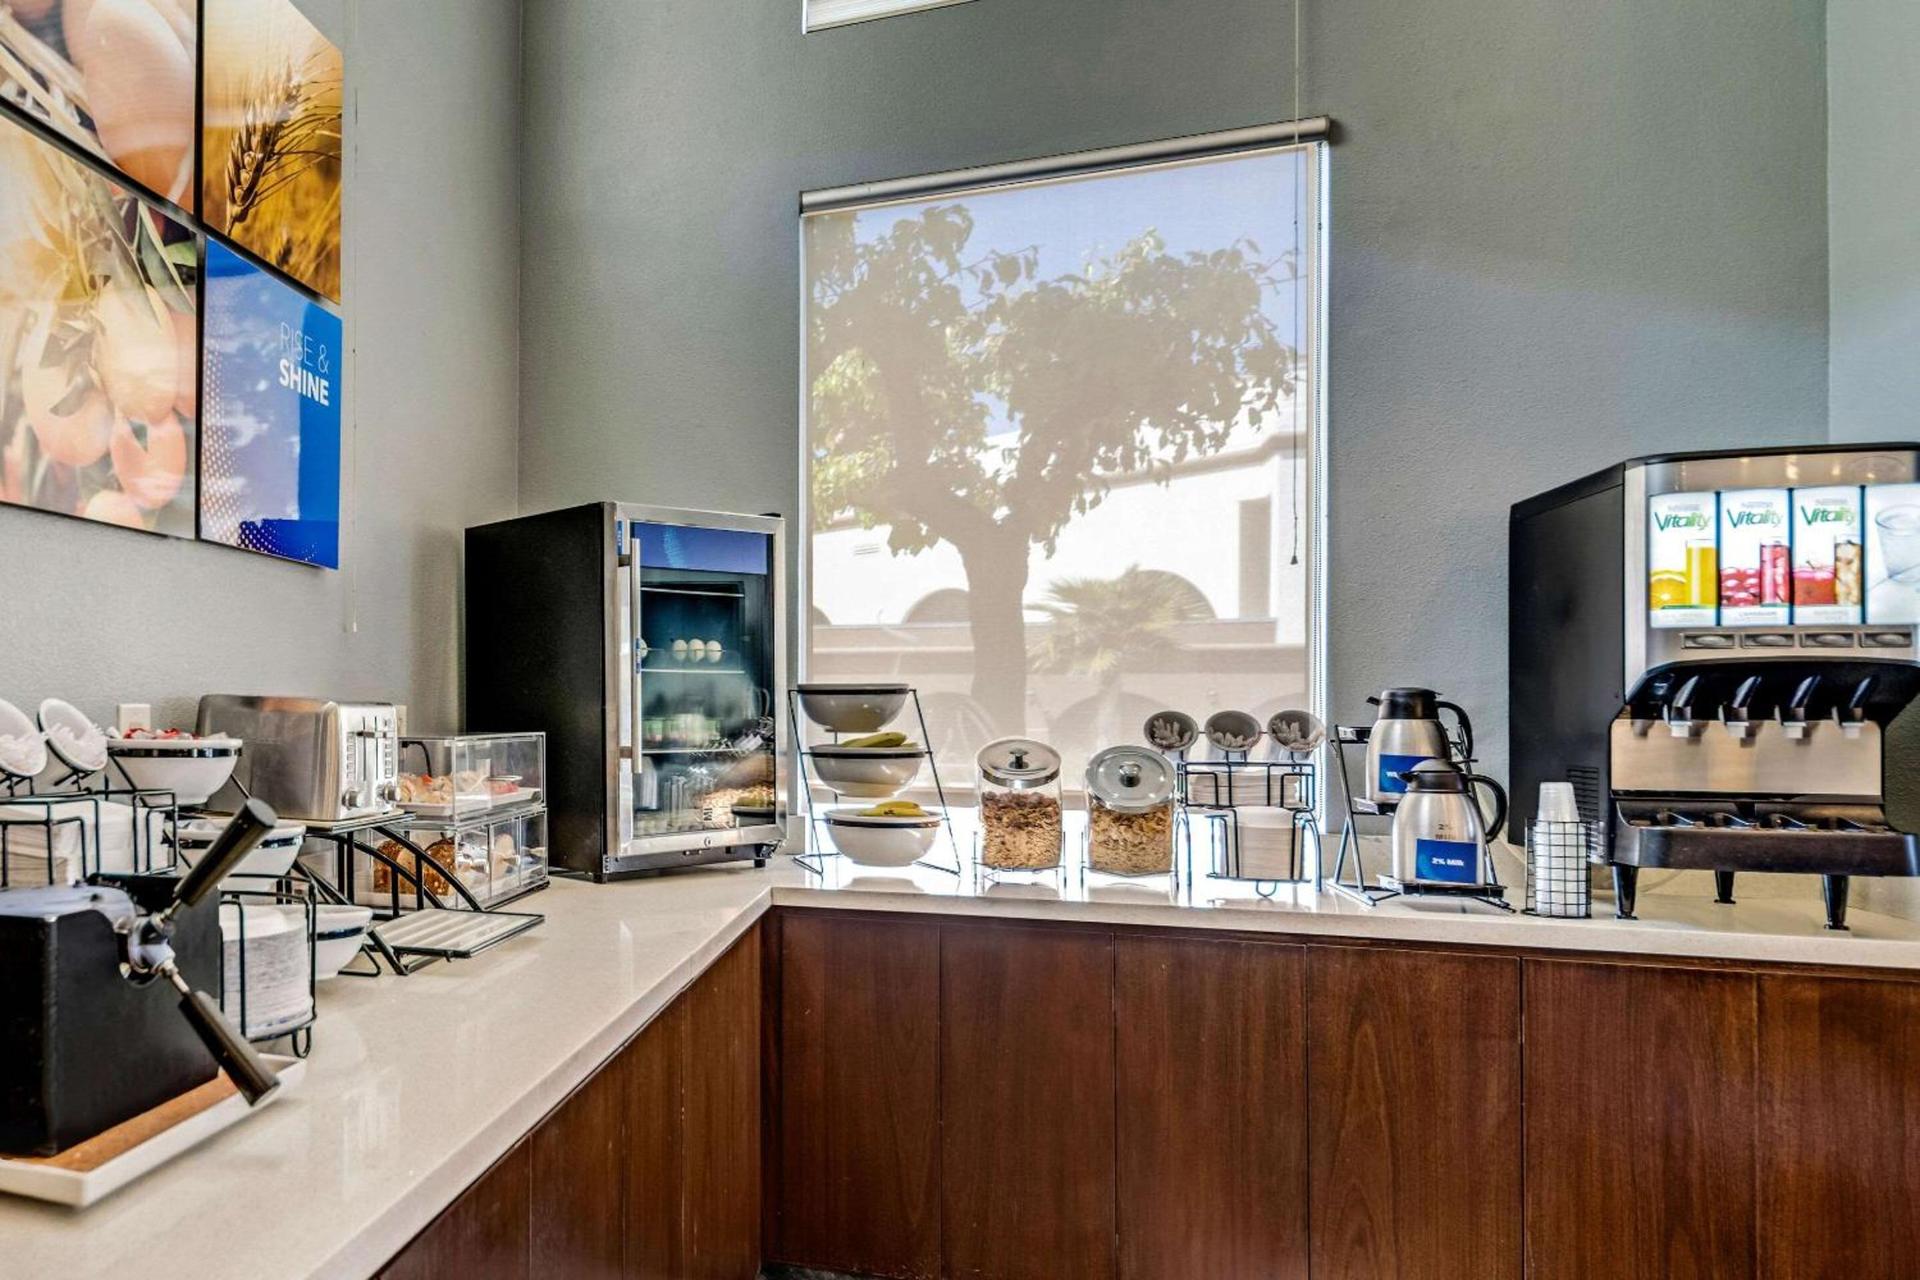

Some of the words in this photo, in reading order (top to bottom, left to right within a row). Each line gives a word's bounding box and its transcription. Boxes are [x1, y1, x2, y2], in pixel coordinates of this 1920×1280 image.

[281, 322, 313, 367] RISE
[318, 344, 329, 374] &
[279, 358, 330, 406] SHINE
[1654, 511, 1711, 532] Vitality
[1726, 508, 1783, 529] Vitality
[1800, 505, 1856, 526] Vitality
